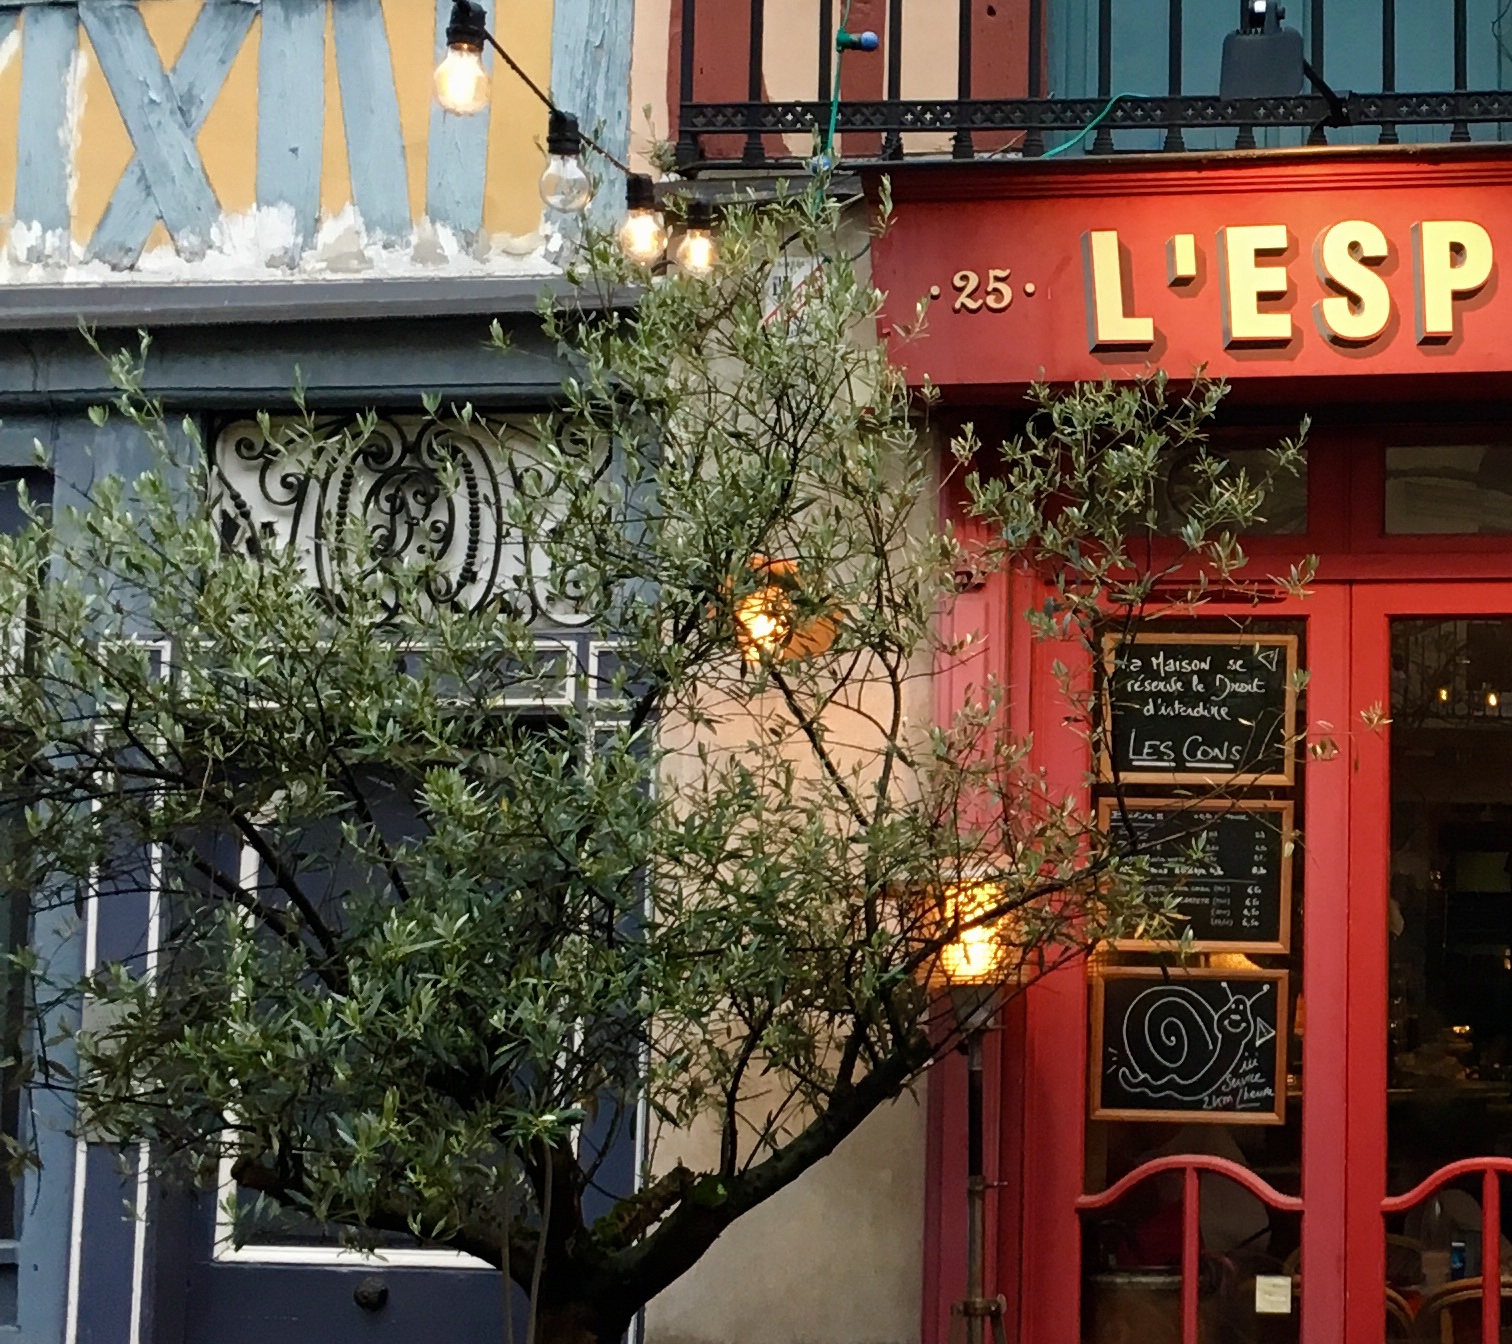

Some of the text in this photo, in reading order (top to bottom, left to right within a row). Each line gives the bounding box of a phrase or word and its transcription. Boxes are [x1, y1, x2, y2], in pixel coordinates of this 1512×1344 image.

[952, 268, 1014, 314] 25
[1127, 674, 1265, 700] réserve le Droit
[1143, 698, 1231, 720] d'interdire
[1128, 728, 1175, 761] LES
